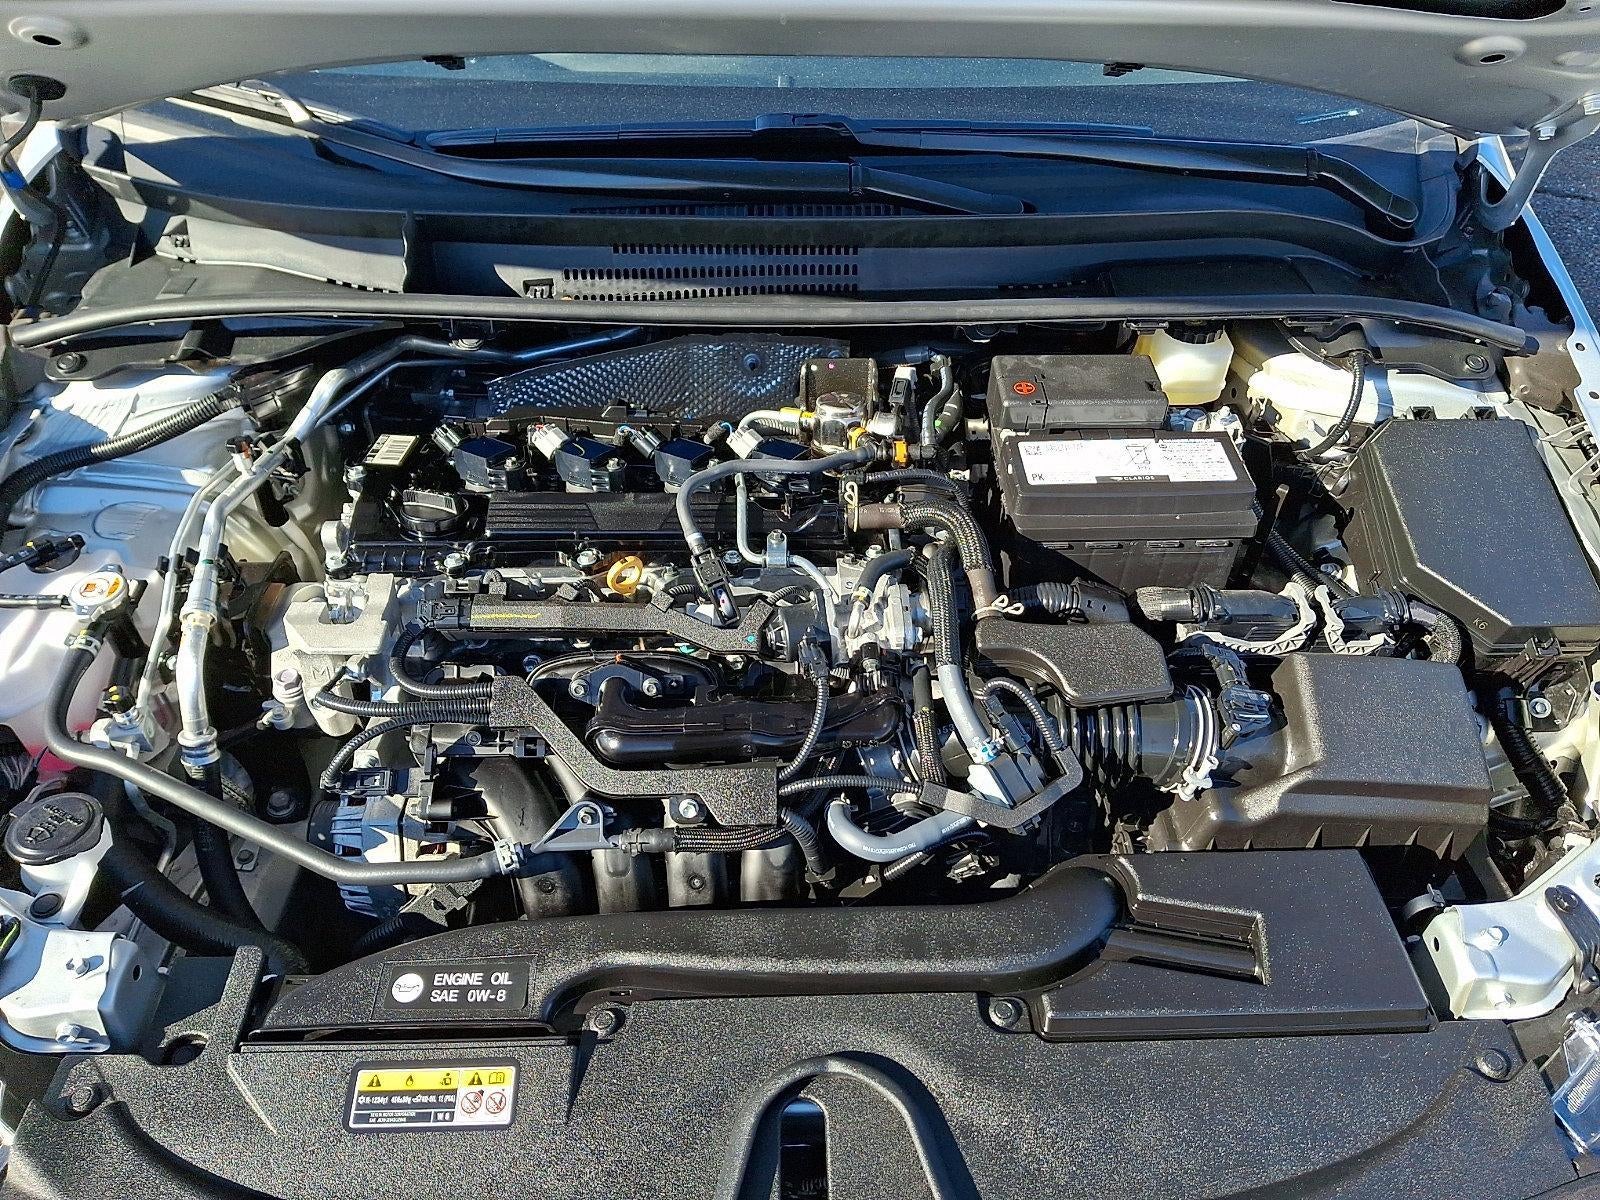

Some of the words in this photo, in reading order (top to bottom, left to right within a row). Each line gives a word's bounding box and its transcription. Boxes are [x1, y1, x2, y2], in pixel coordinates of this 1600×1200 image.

[433, 973, 484, 986] ENGINE
[490, 972, 513, 986] OIL
[430, 989, 459, 1003] SAE
[467, 989, 507, 1002] 0W-8
